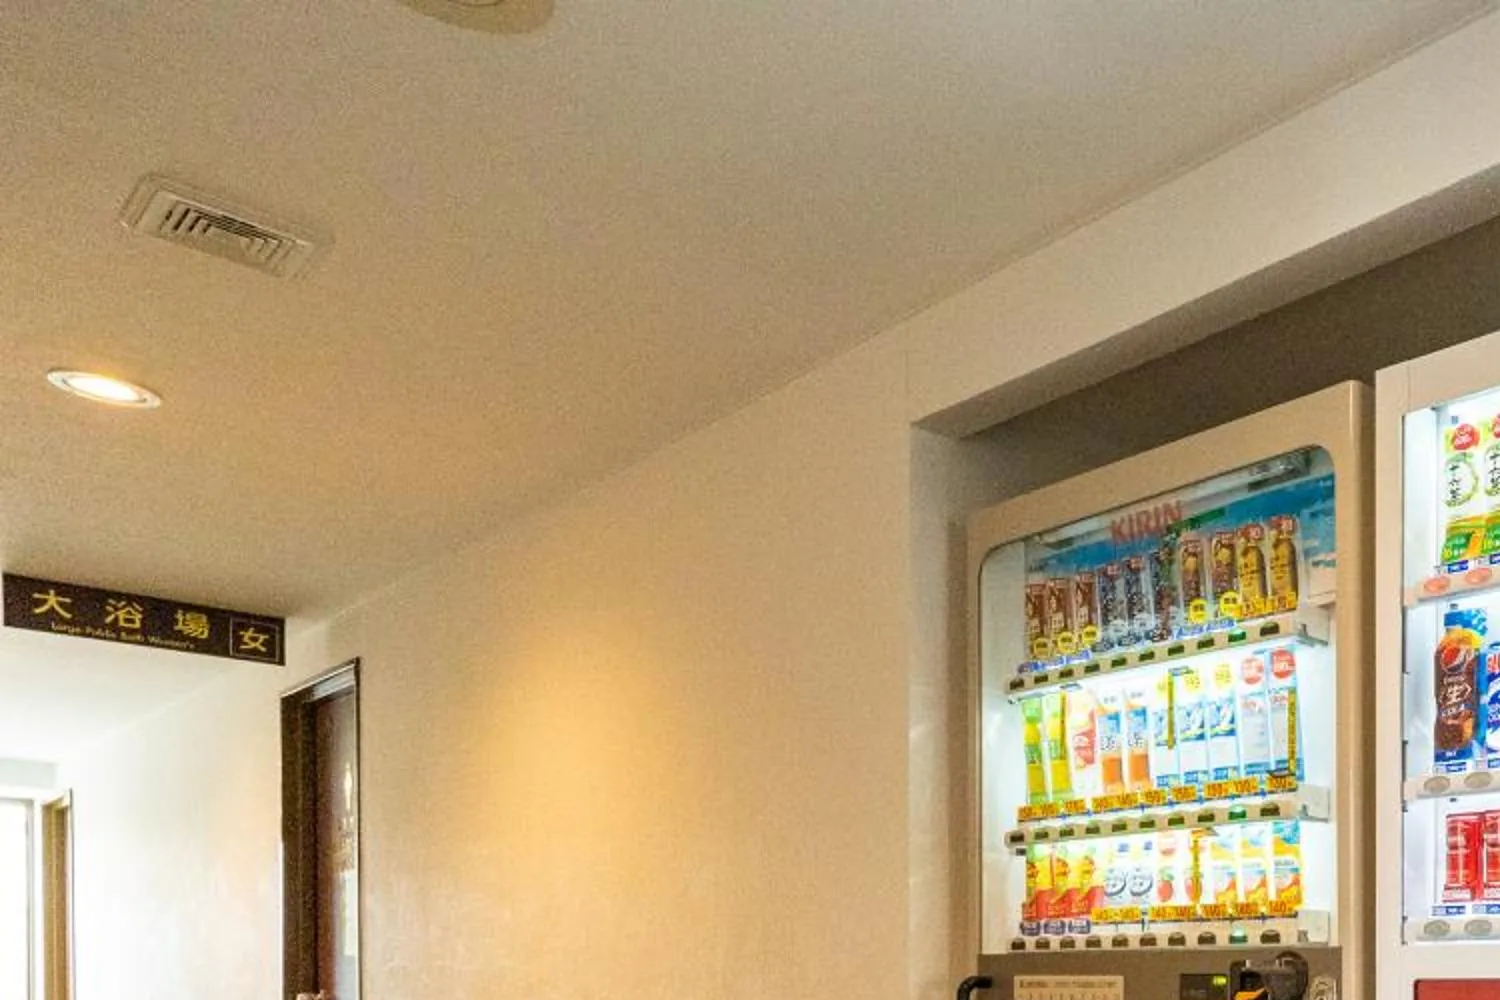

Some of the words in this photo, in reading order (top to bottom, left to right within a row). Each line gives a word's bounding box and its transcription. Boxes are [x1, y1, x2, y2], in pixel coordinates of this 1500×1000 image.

[1109, 500, 1183, 543] KIRIN
[32, 590, 210, 640] 大浴場
[239, 628, 269, 652] 女
